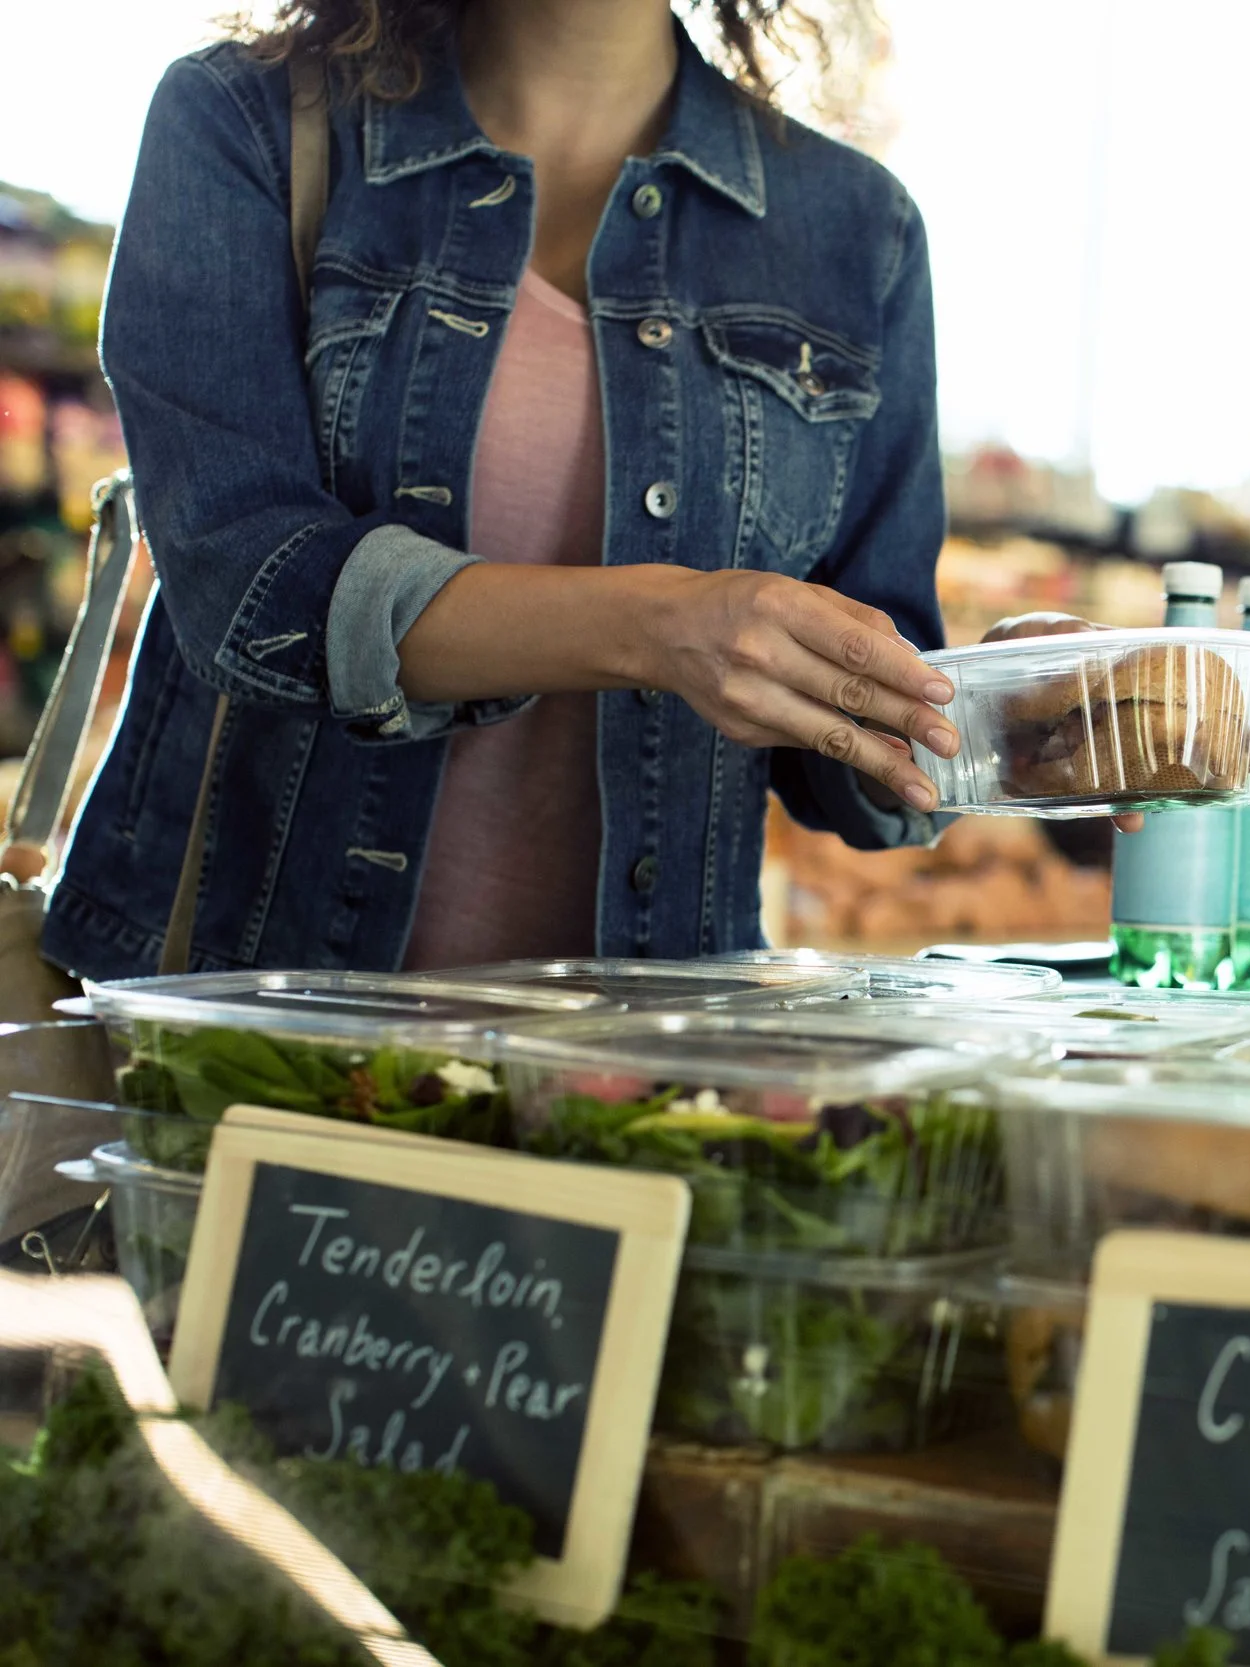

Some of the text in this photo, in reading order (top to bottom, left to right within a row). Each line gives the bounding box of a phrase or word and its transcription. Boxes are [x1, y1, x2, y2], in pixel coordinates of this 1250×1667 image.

[250, 1282, 453, 1408] Cranberry
[485, 1340, 584, 1420] Pear
[304, 1378, 471, 1476] Salad
